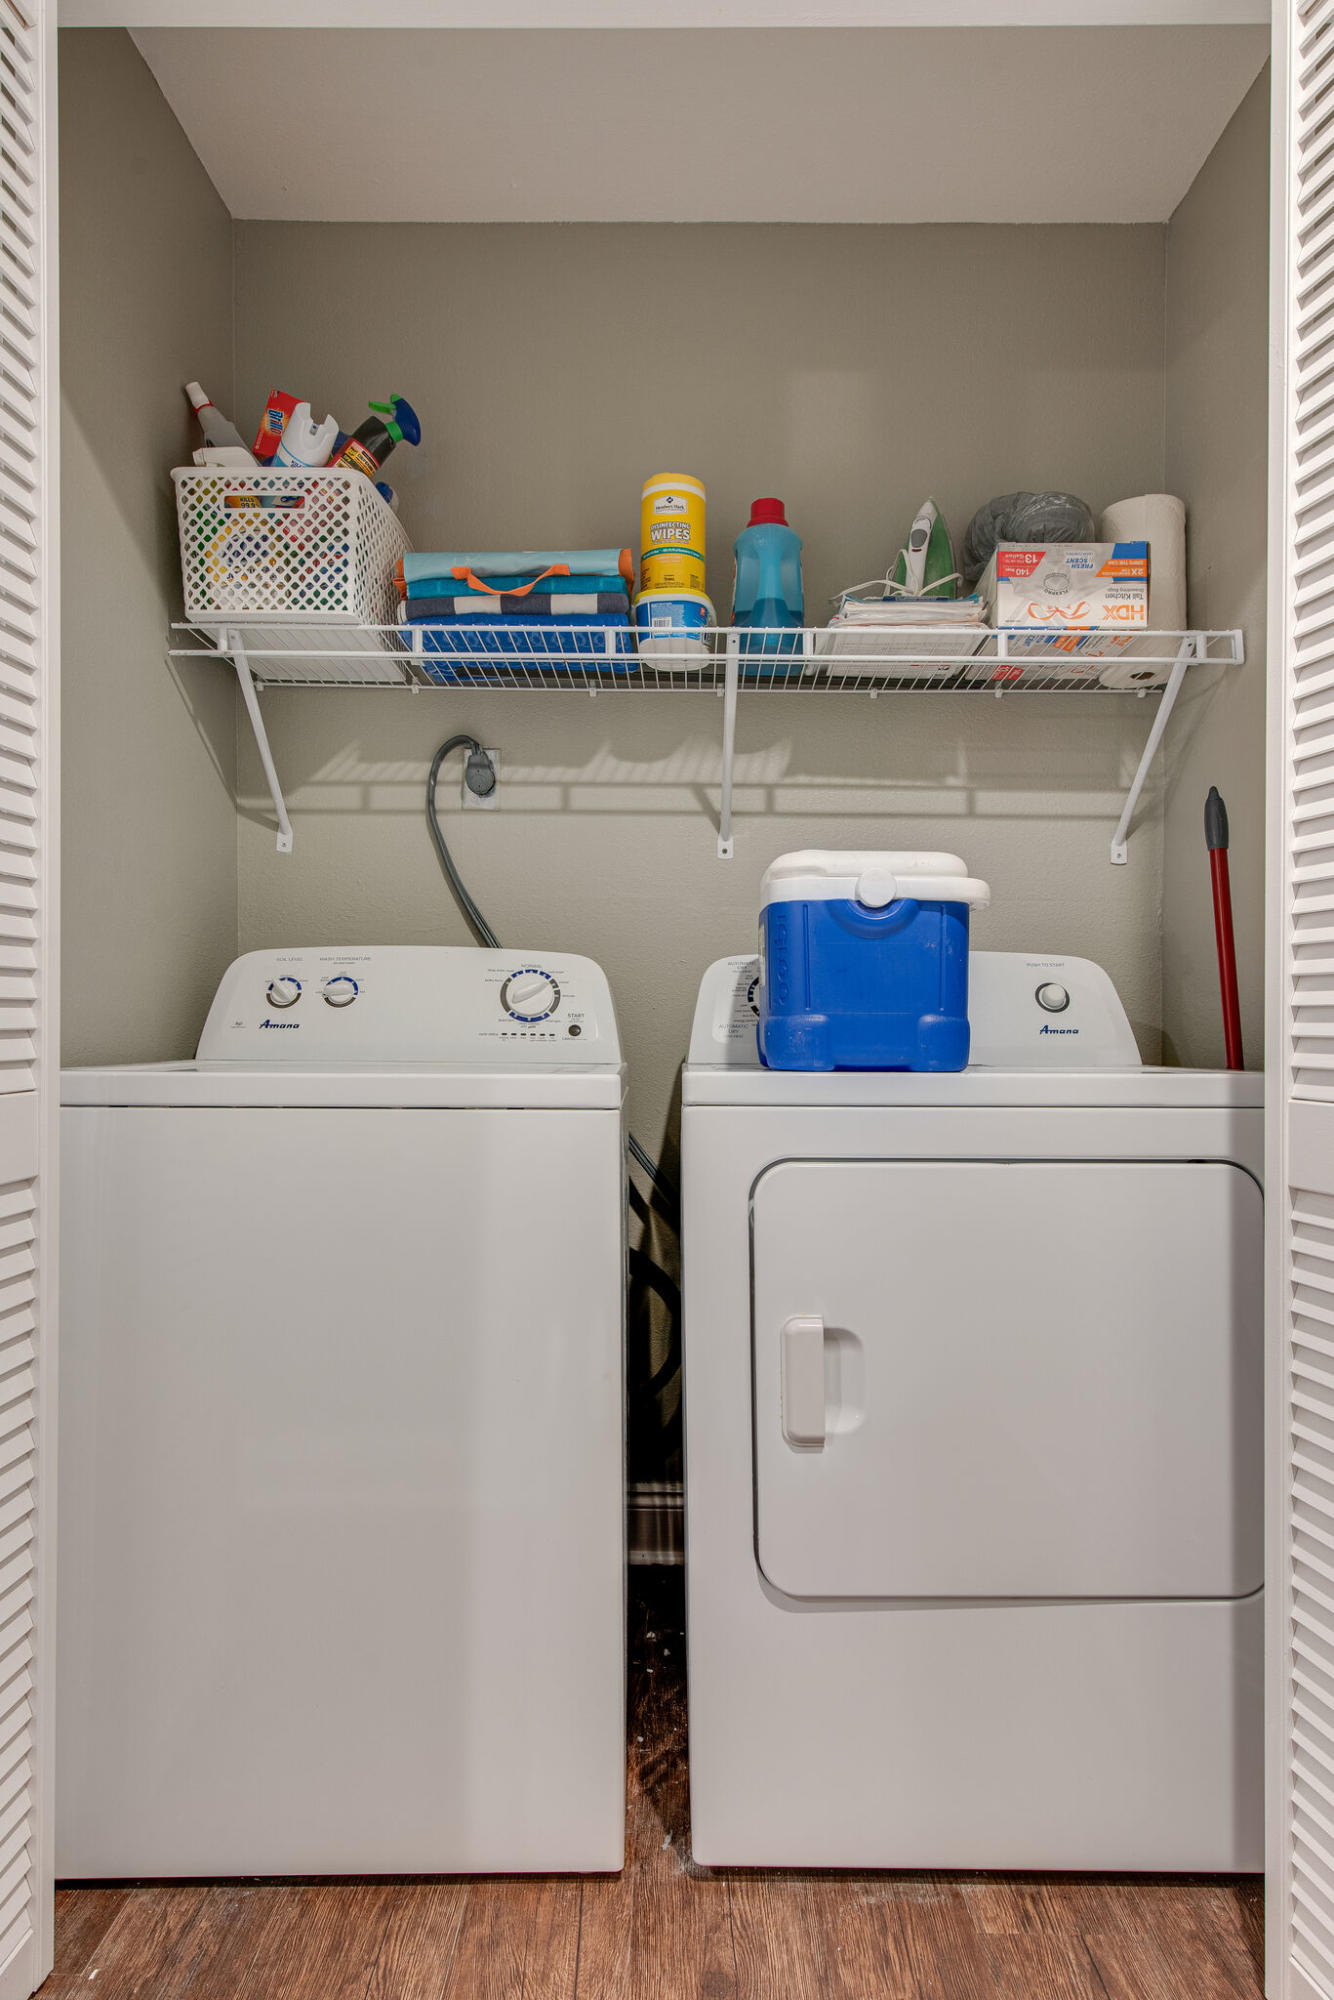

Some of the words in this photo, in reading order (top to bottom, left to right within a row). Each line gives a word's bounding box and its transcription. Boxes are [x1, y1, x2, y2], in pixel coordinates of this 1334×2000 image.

[268, 409, 284, 435] Brillo
[650, 521, 690, 529] DISINFECTING
[650, 528, 690, 542] WIPES
[1025, 553, 1037, 563] 13
[1103, 605, 1144, 620] HDX
[259, 1019, 300, 1029] Amana
[1039, 1025, 1079, 1035] Amana
